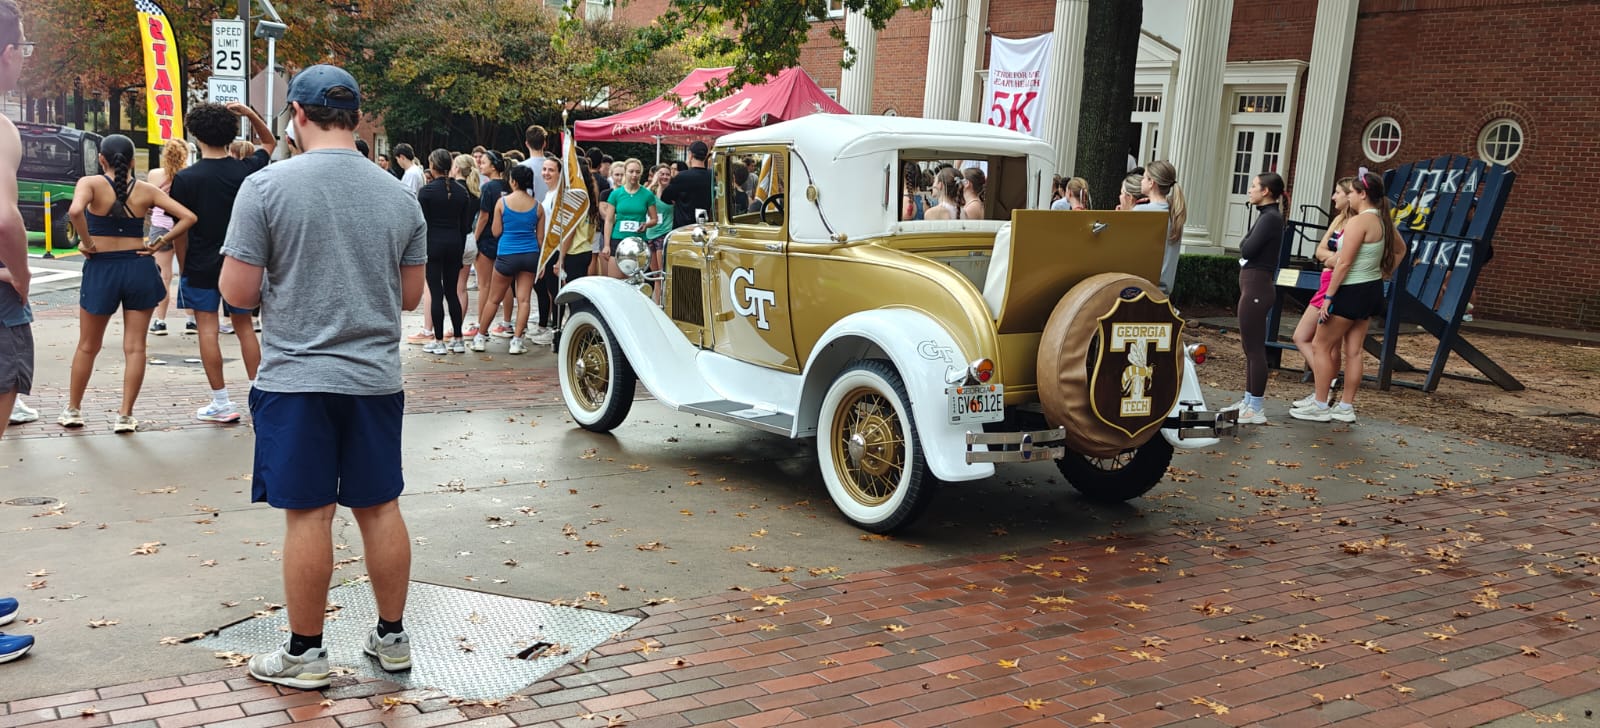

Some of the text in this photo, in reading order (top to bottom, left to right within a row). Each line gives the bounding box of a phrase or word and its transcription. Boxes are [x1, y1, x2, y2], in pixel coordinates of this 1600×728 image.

[215, 26, 242, 36] SPEED
[218, 39, 239, 48] LIMIT
[216, 50, 242, 70] 25
[216, 84, 238, 93] YOUR
[215, 96, 240, 104] SPEED
[987, 90, 1038, 132] 5K
[623, 222, 636, 230] 52
[729, 266, 777, 331] GT
[1116, 326, 1167, 338] GEORGIA
[917, 340, 954, 363] GT
[957, 394, 1003, 415] GV6512E
[1124, 400, 1149, 412] TECH
